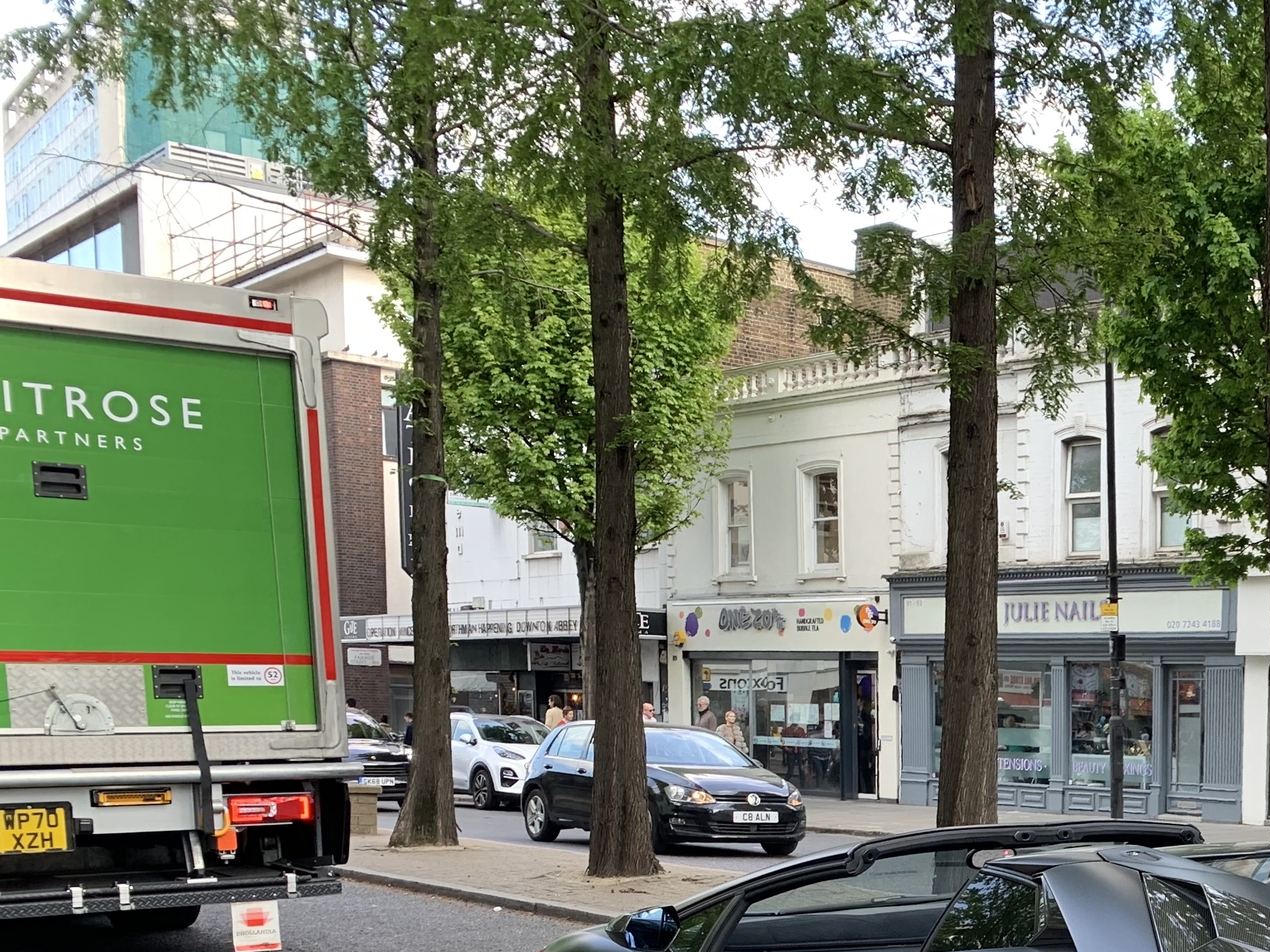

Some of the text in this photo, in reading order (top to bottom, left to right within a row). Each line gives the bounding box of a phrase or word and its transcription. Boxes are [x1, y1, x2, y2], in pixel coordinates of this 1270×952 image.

[2, 380, 204, 430] ITROSE
[0, 426, 143, 451] PARTNERS
[1003, 601, 1050, 626] JULIE
[1055, 600, 1108, 622] NAIL
[1166, 620, 1180, 629] 020
[1182, 620, 1200, 628] 7243
[267, 670, 278, 678] 52
[1072, 762, 1107, 774] BEAUTY
[3, 812, 59, 831] WP70
[742, 812, 771, 821] C8 ALN
[12, 832, 54, 850] XZH
